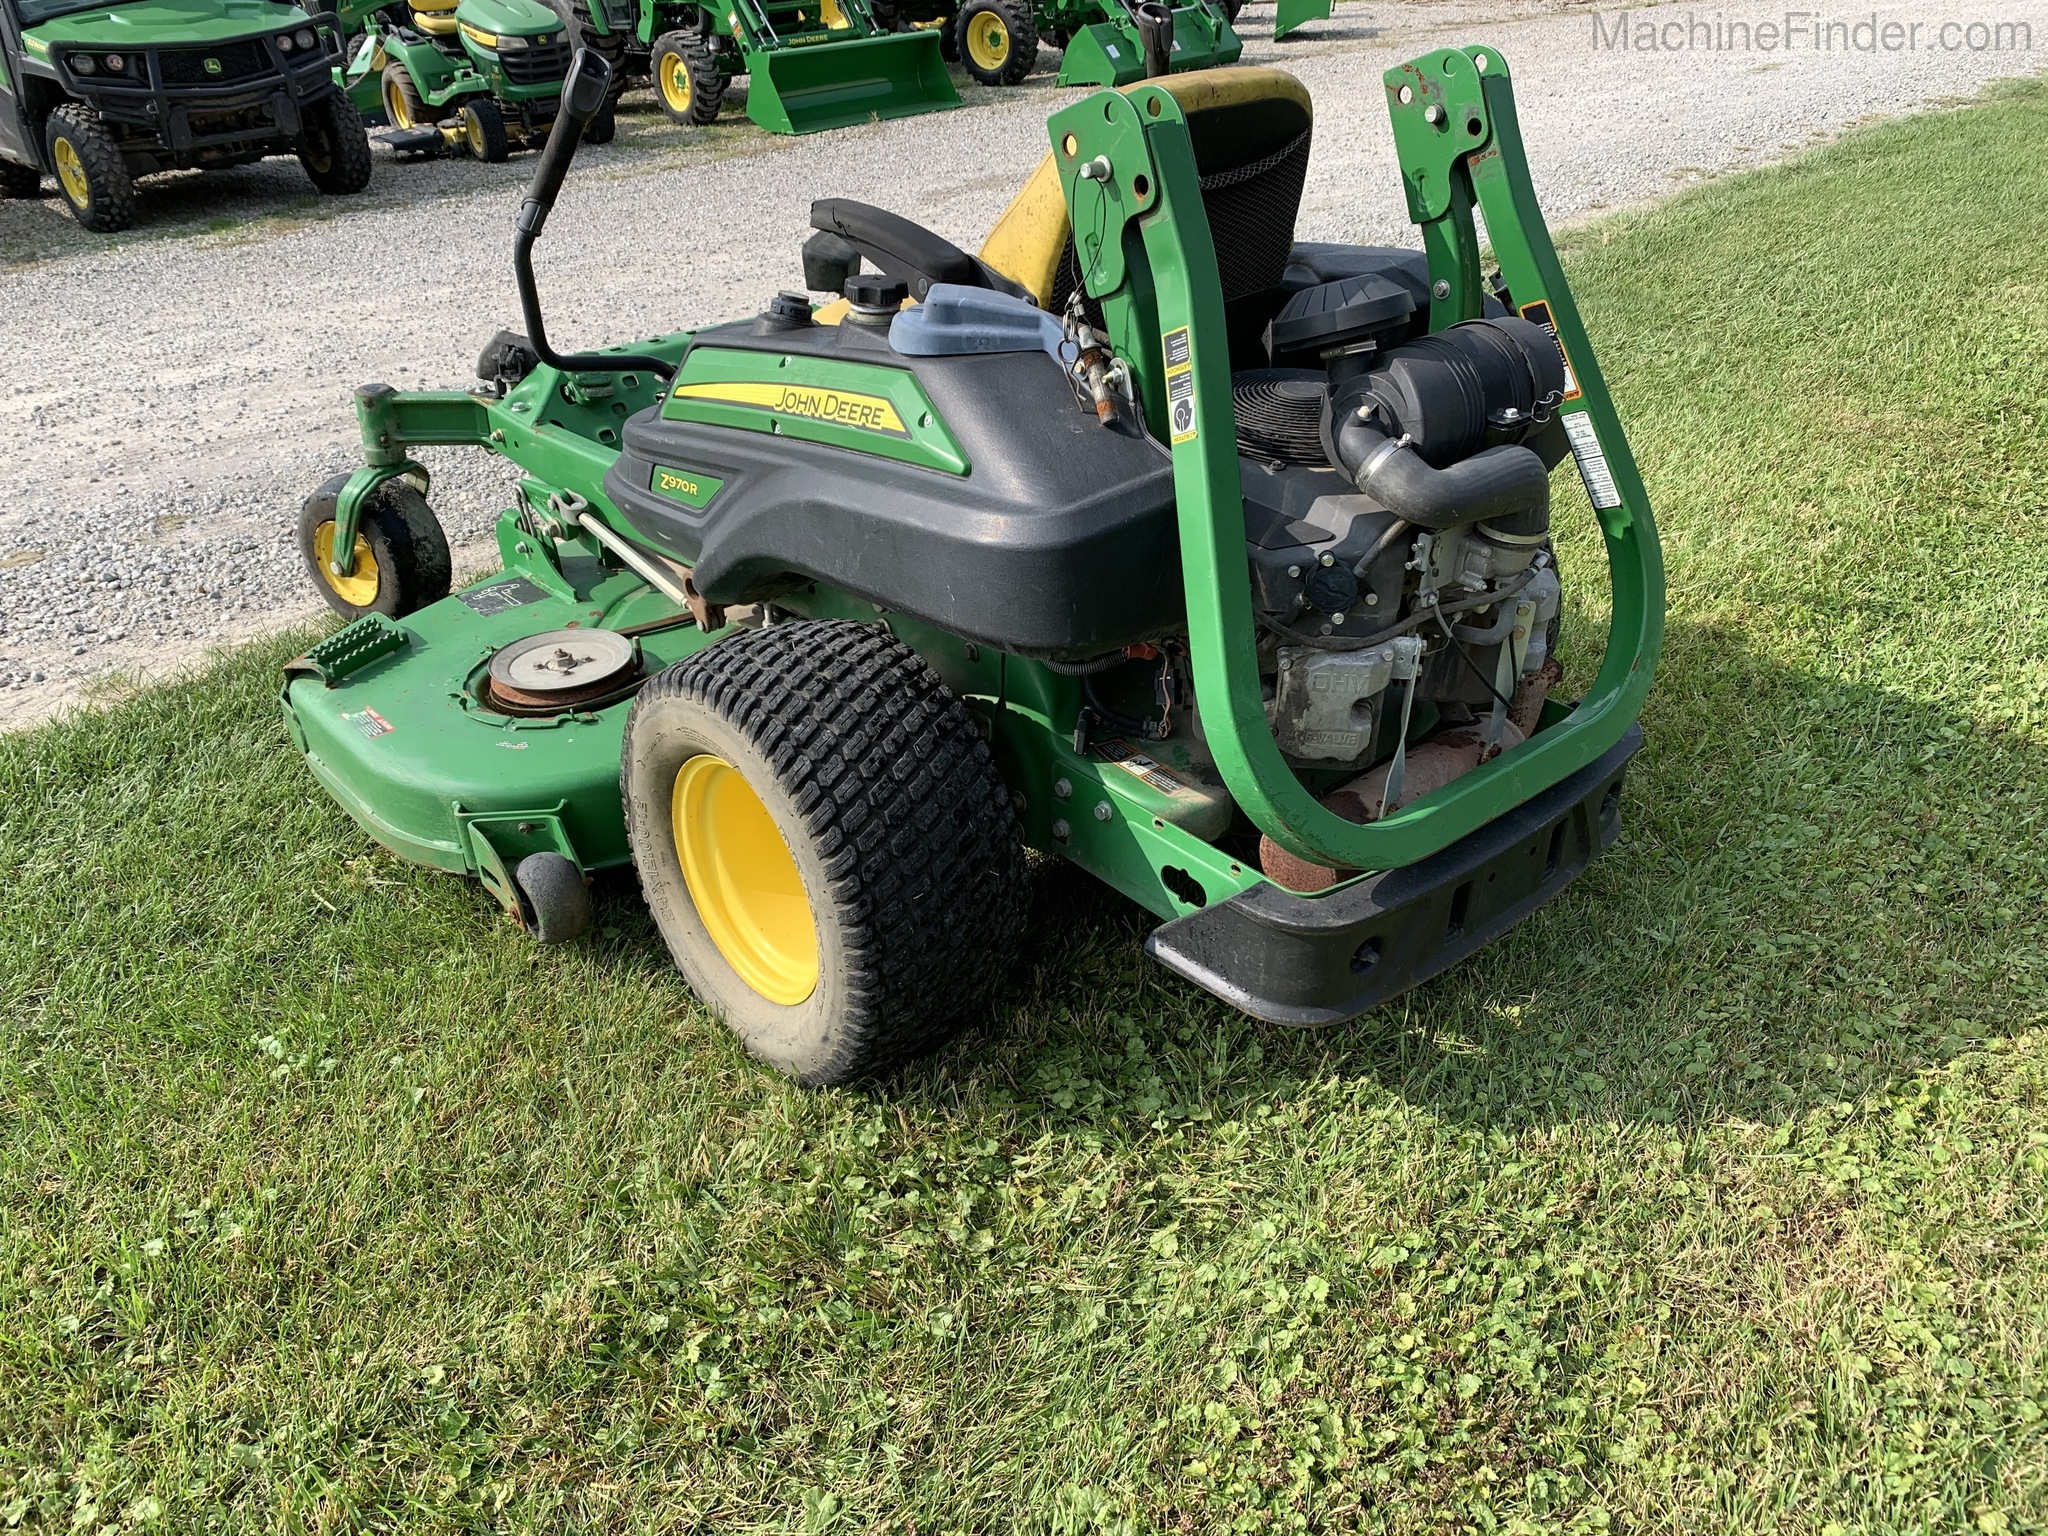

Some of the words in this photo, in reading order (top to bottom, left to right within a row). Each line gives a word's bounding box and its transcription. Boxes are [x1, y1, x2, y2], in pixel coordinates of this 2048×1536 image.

[788, 36, 806, 46] JOHN
[805, 34, 829, 43] DEERE
[774, 387, 822, 414] JOHN
[822, 394, 885, 426] DEERE
[660, 472, 698, 496] Z970R
[1311, 672, 1369, 694] OHV
